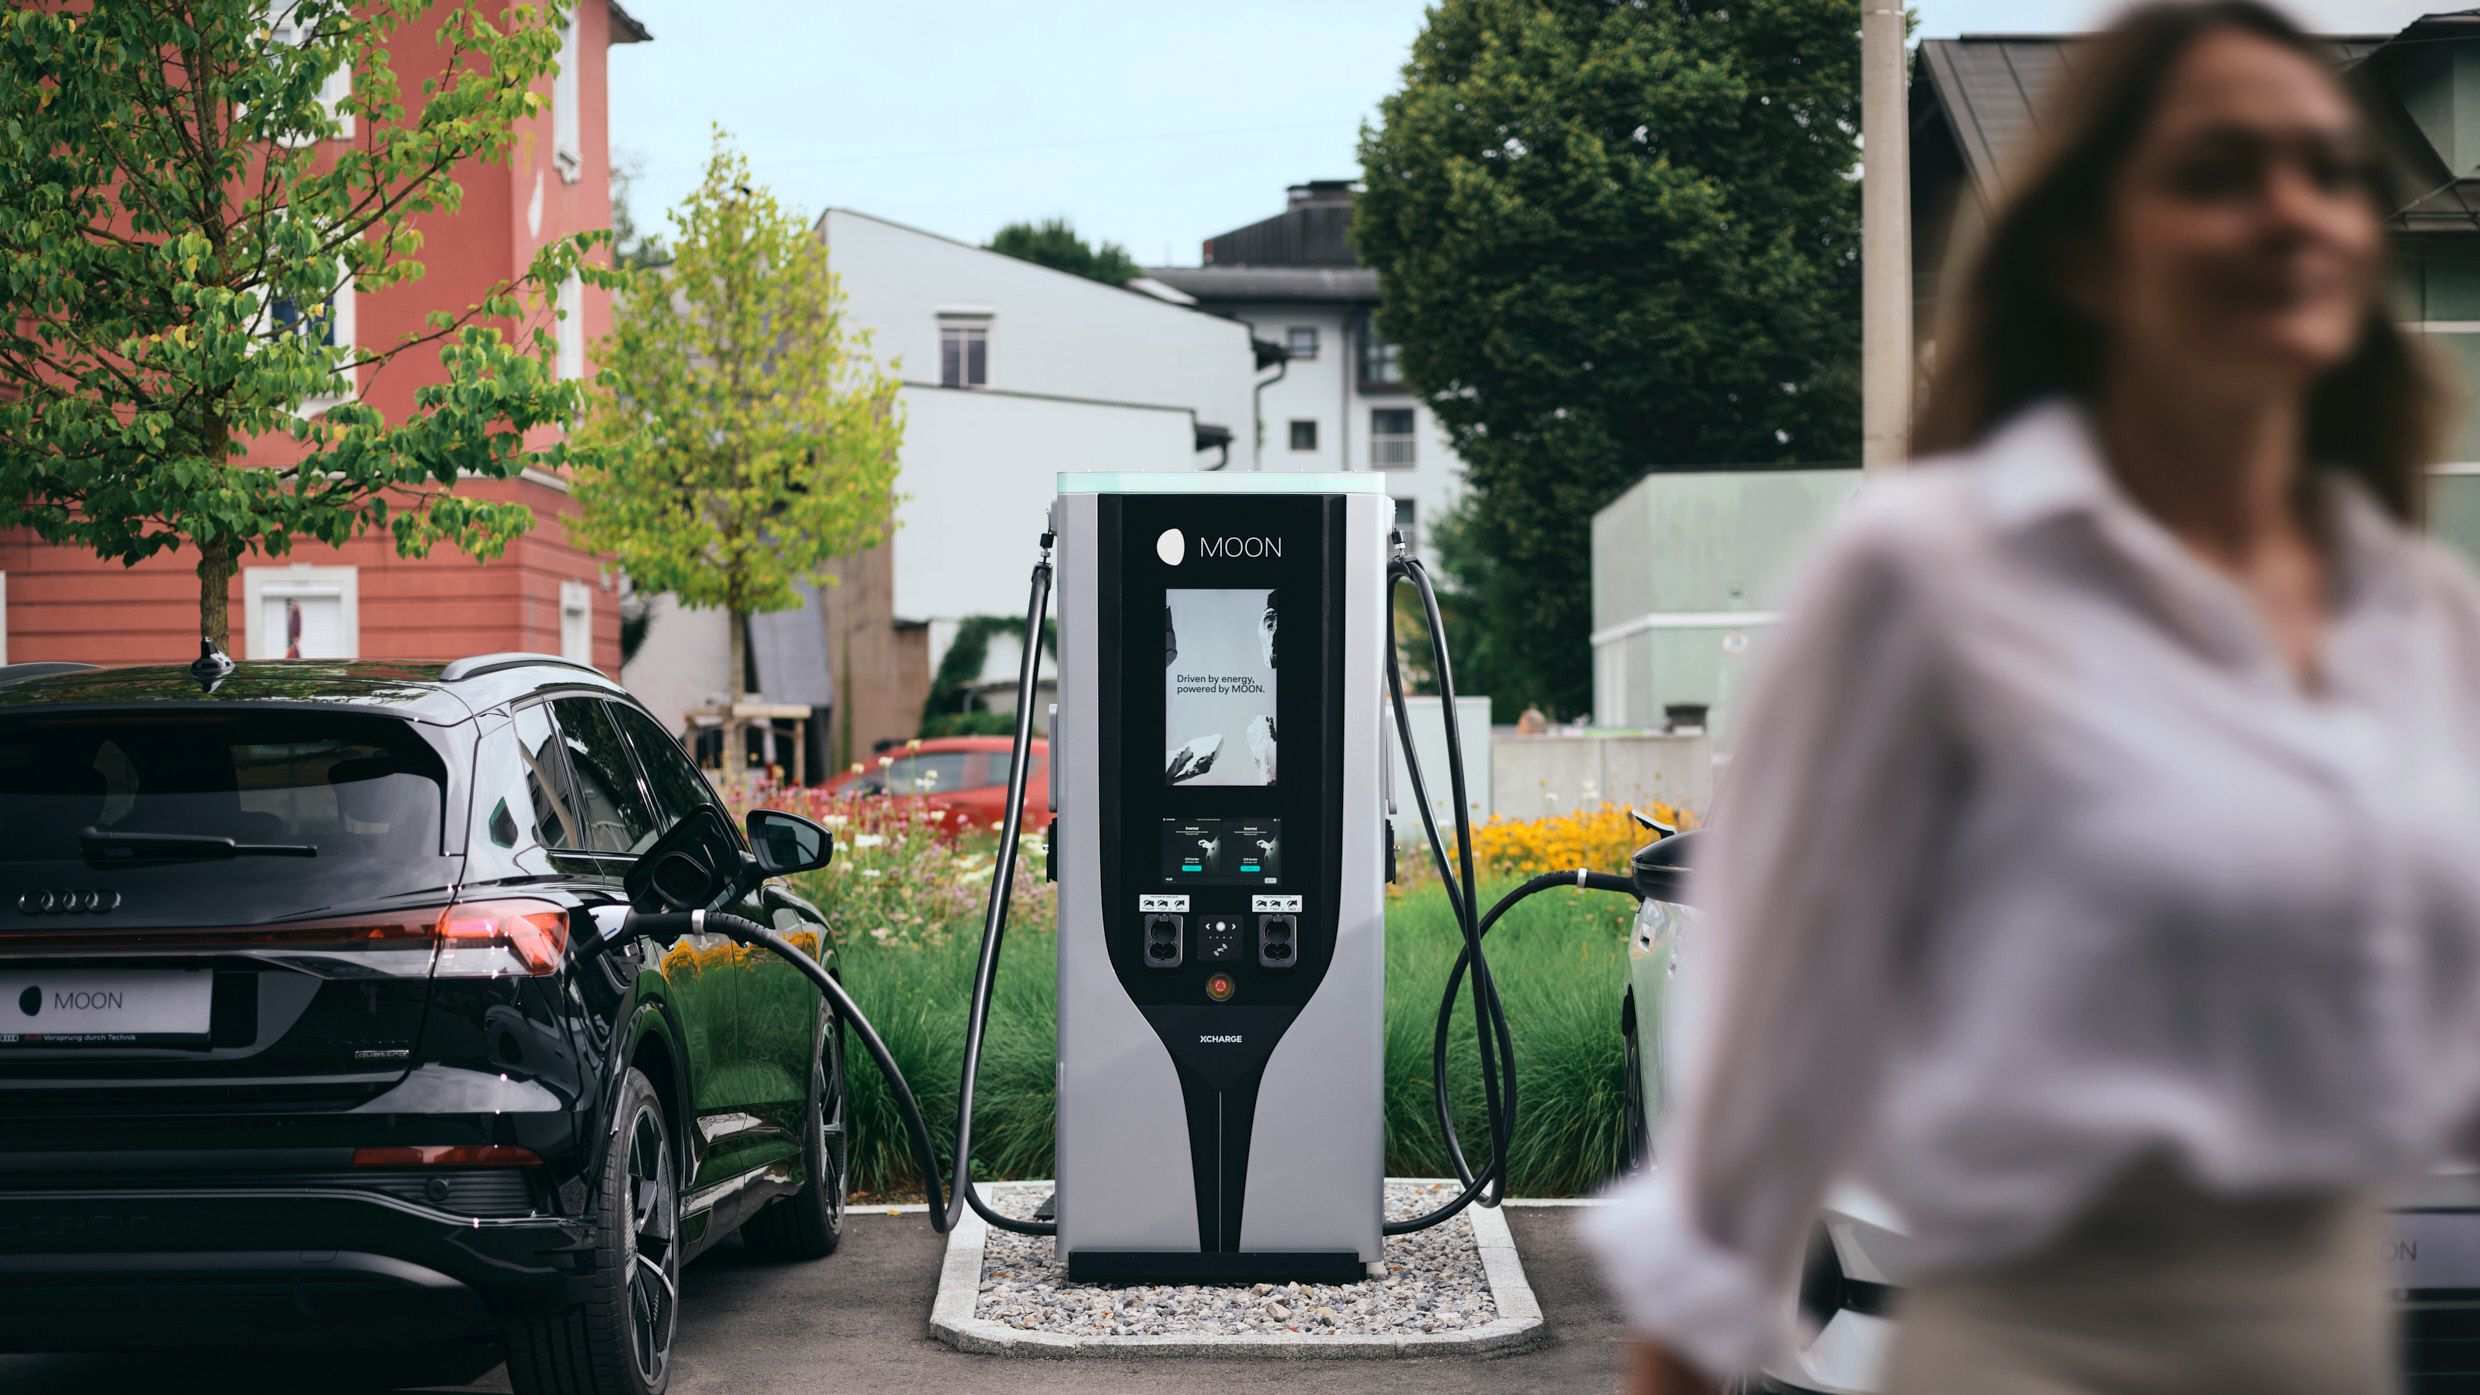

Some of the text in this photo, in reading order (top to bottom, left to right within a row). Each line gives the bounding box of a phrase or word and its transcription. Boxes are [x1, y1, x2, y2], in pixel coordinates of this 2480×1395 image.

[1200, 536, 1282, 558] MOON
[1177, 674, 1255, 685] Driven by energy,
[1177, 683, 1266, 695] powered by MOON.
[54, 990, 123, 1010] MOON
[44, 1034, 82, 1042] Vorsprung
[1199, 1034, 1243, 1044] XCHARGE
[2380, 1240, 2417, 1262] ON
